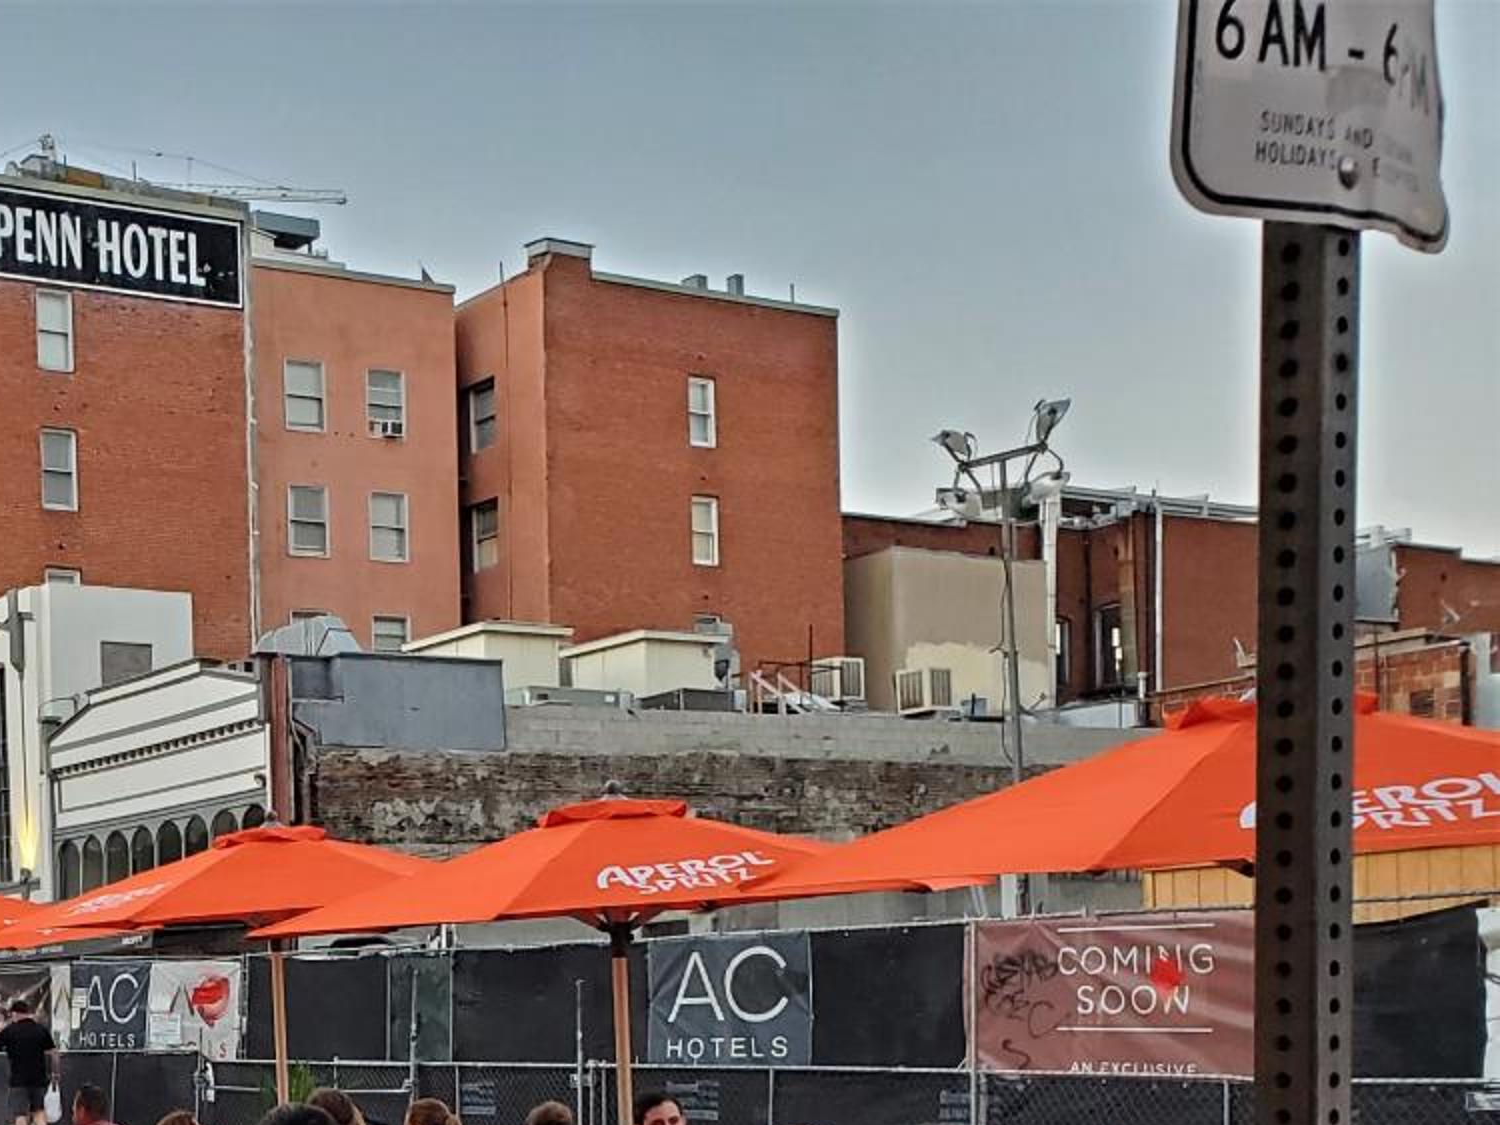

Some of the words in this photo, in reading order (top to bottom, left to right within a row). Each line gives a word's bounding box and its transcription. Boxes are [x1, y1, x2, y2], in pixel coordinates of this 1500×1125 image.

[1257, 0, 1327, 71] AM
[1260, 109, 1336, 141] SUNDAYS
[1255, 140, 1336, 171] HOLIDAYS
[96, 218, 207, 286] HOTEL
[597, 851, 776, 889] APEROL
[1058, 943, 1214, 976] COMING
[82, 973, 140, 1025] AC
[667, 945, 789, 1023] AC
[1076, 983, 1190, 1016] SOON
[79, 1032, 136, 1048] HOTELS
[666, 1035, 789, 1058] HOTELS
[1071, 1061, 1094, 1074] AN
[1100, 1061, 1198, 1075] EXCLUSIVE
